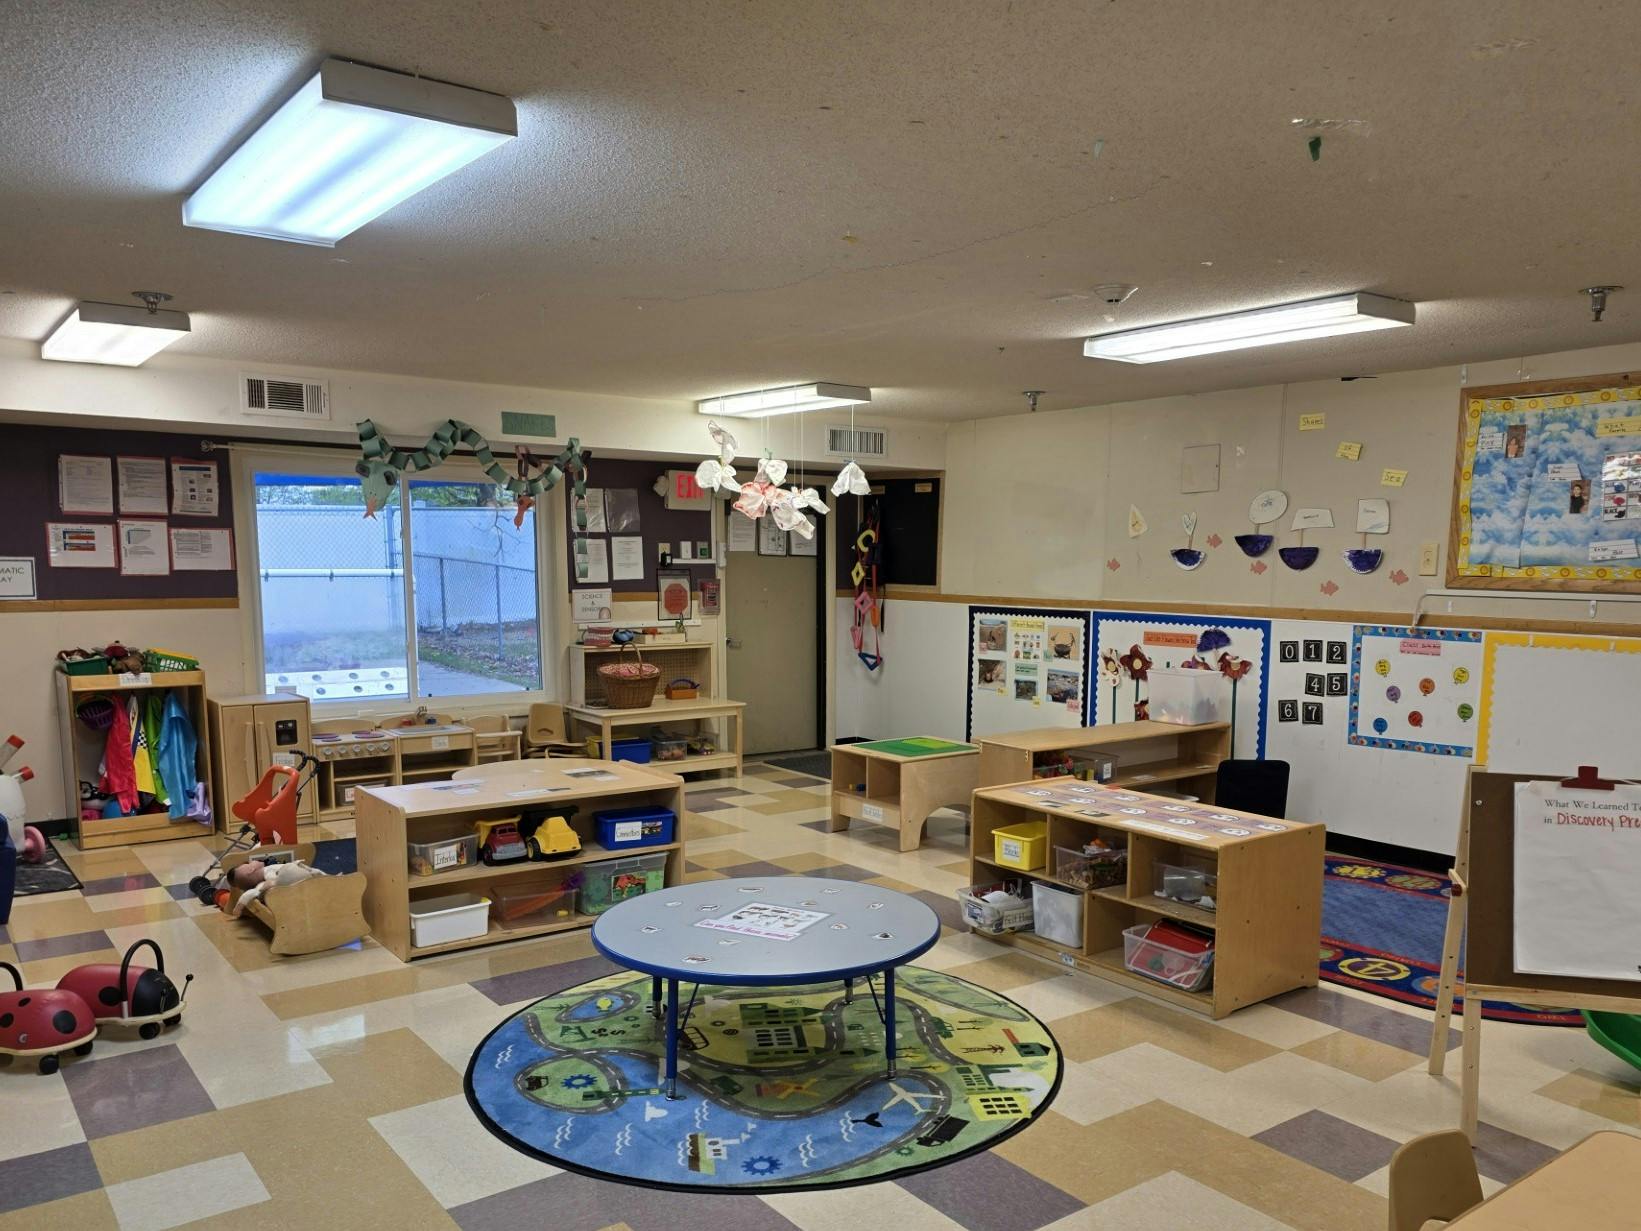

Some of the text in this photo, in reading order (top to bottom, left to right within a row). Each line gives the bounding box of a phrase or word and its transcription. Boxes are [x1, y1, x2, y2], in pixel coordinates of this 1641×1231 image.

[676, 474, 705, 497] EX
[1285, 644, 1341, 660] 0 1 2
[1311, 677, 1341, 692] 4 5
[1284, 703, 1318, 720] 6 7
[1544, 799, 1569, 809] What
[1573, 800, 1590, 809] We
[1592, 801, 1629, 811] Learned
[1544, 816, 1553, 824] in
[1557, 812, 1614, 832] Discovery
